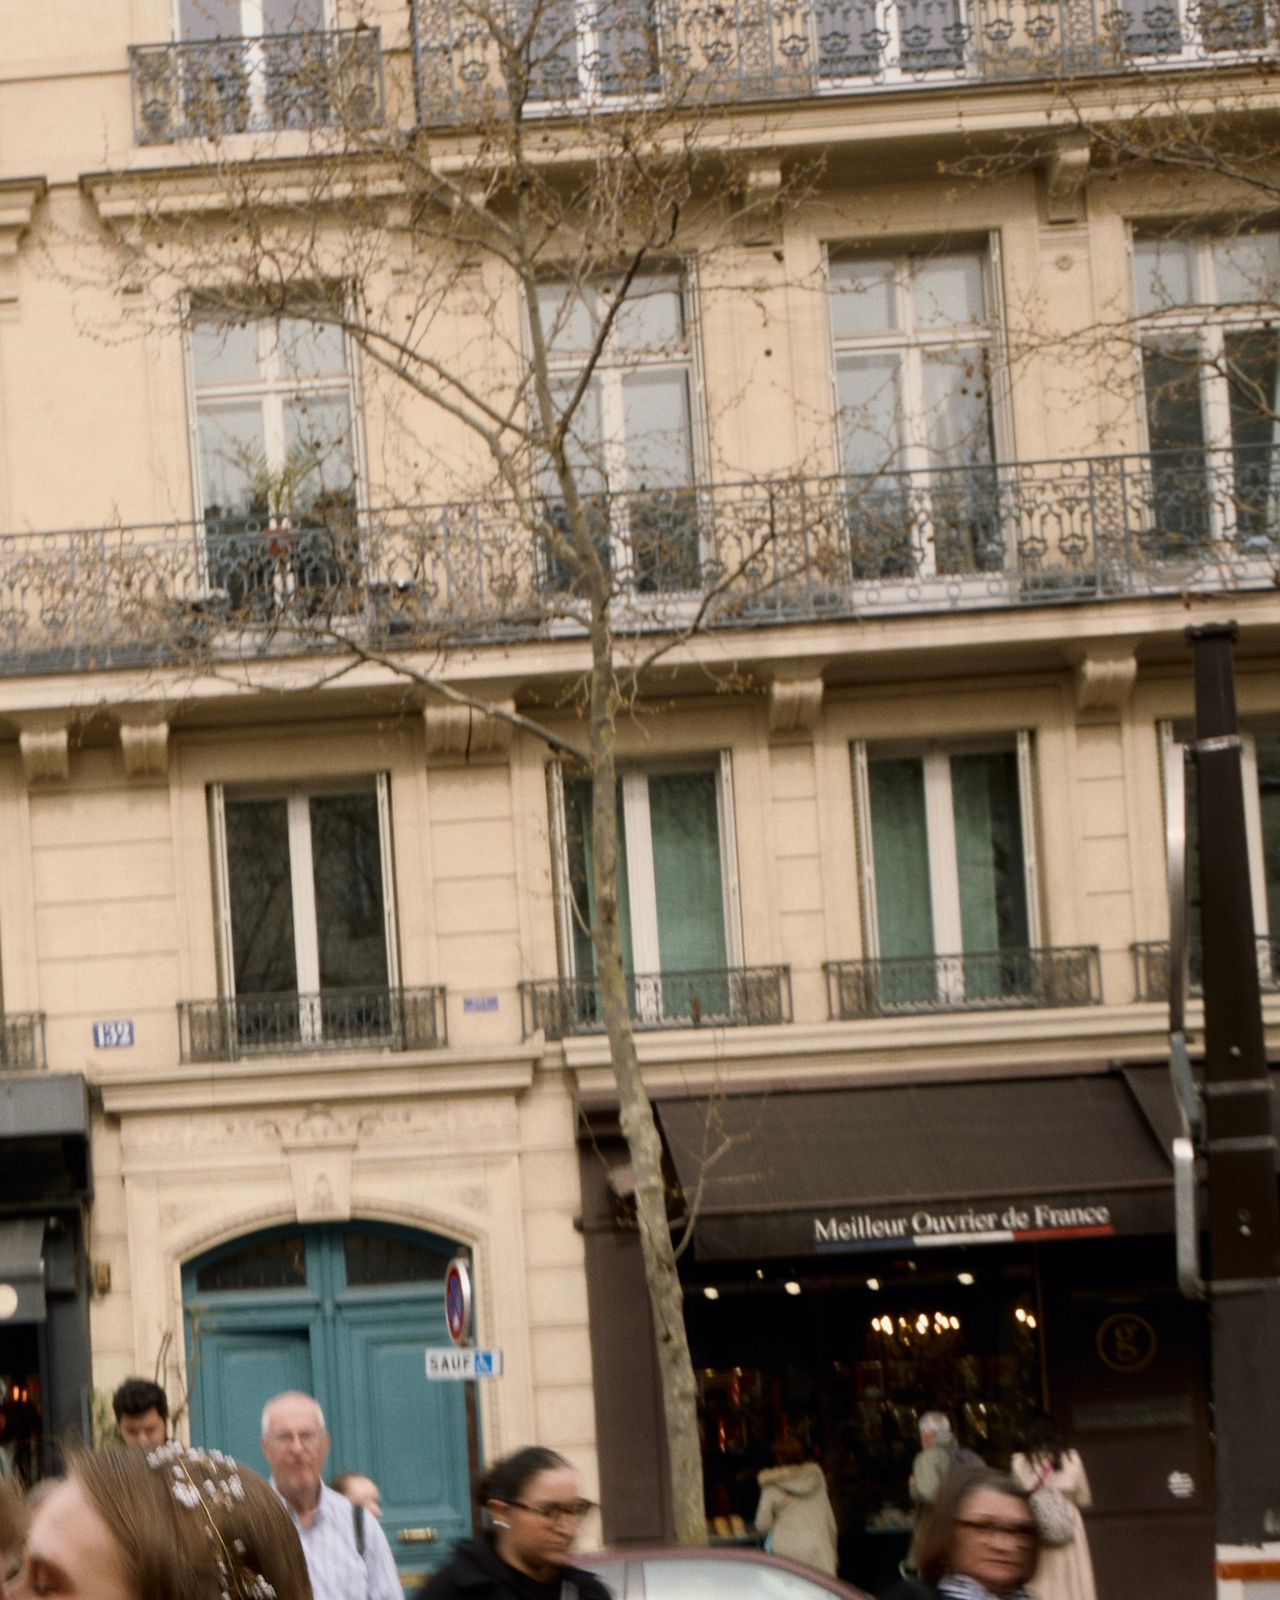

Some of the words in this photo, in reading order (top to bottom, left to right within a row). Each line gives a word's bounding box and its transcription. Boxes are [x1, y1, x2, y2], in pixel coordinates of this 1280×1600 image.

[98, 1020, 131, 1047] 132
[814, 1214, 908, 1242] Meilleur
[912, 1208, 998, 1234] Ouvrier
[1001, 1205, 1030, 1229] de
[1034, 1204, 1110, 1228] France
[429, 1355, 470, 1372] SAUF
